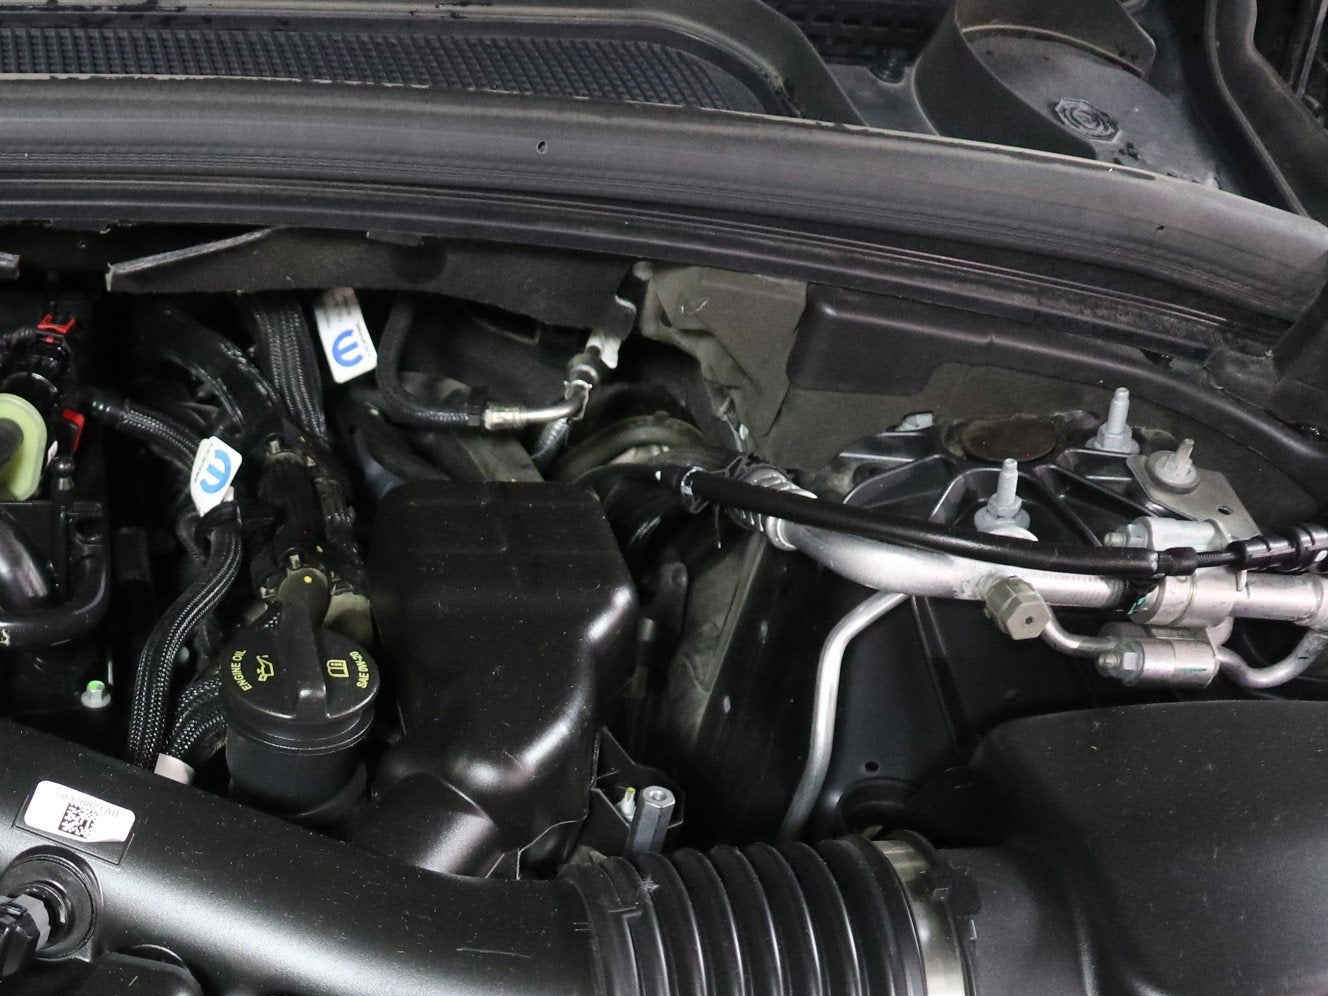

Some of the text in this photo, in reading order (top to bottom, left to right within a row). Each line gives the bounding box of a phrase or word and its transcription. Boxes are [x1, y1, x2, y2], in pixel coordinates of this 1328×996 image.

[230, 650, 253, 691] ENGINE OIL
[349, 650, 370, 689] SAE 0W-20
